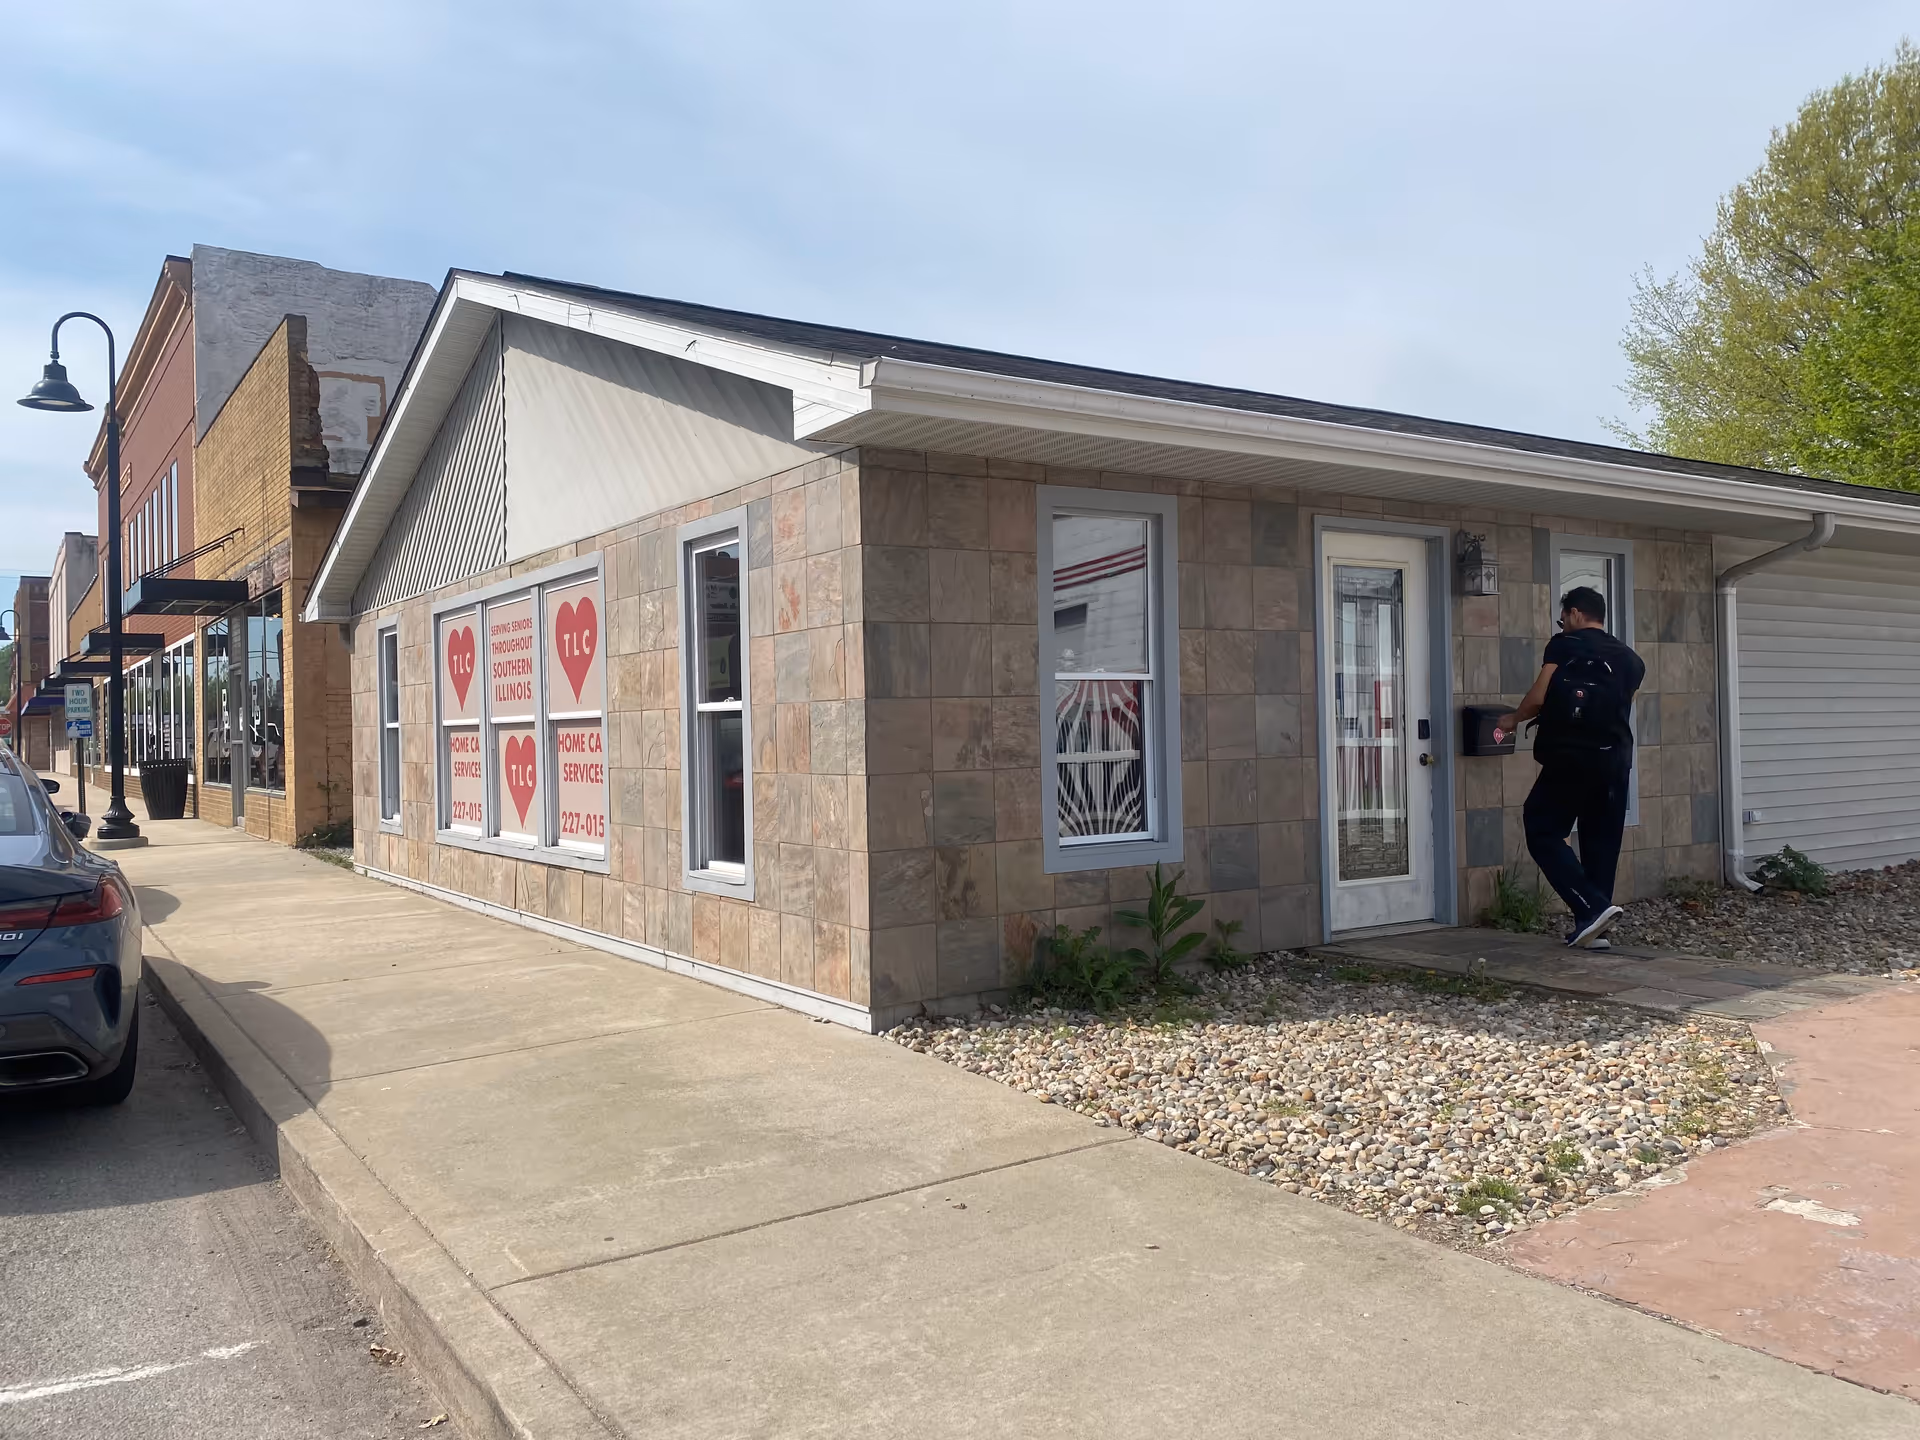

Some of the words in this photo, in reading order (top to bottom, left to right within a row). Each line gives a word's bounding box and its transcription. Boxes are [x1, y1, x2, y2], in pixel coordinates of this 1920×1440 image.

[491, 623, 510, 636] SERVING
[512, 617, 532, 632] SENIORS
[492, 636, 532, 655] THROUGHOUT
[564, 629, 590, 657] TLC
[453, 652, 470, 675] TLC
[493, 657, 532, 679] SOUTHERN
[496, 681, 532, 702] ILLINOIS
[450, 737, 469, 753] HOME
[558, 733, 585, 753] HOME
[511, 764, 533, 787] TLC
